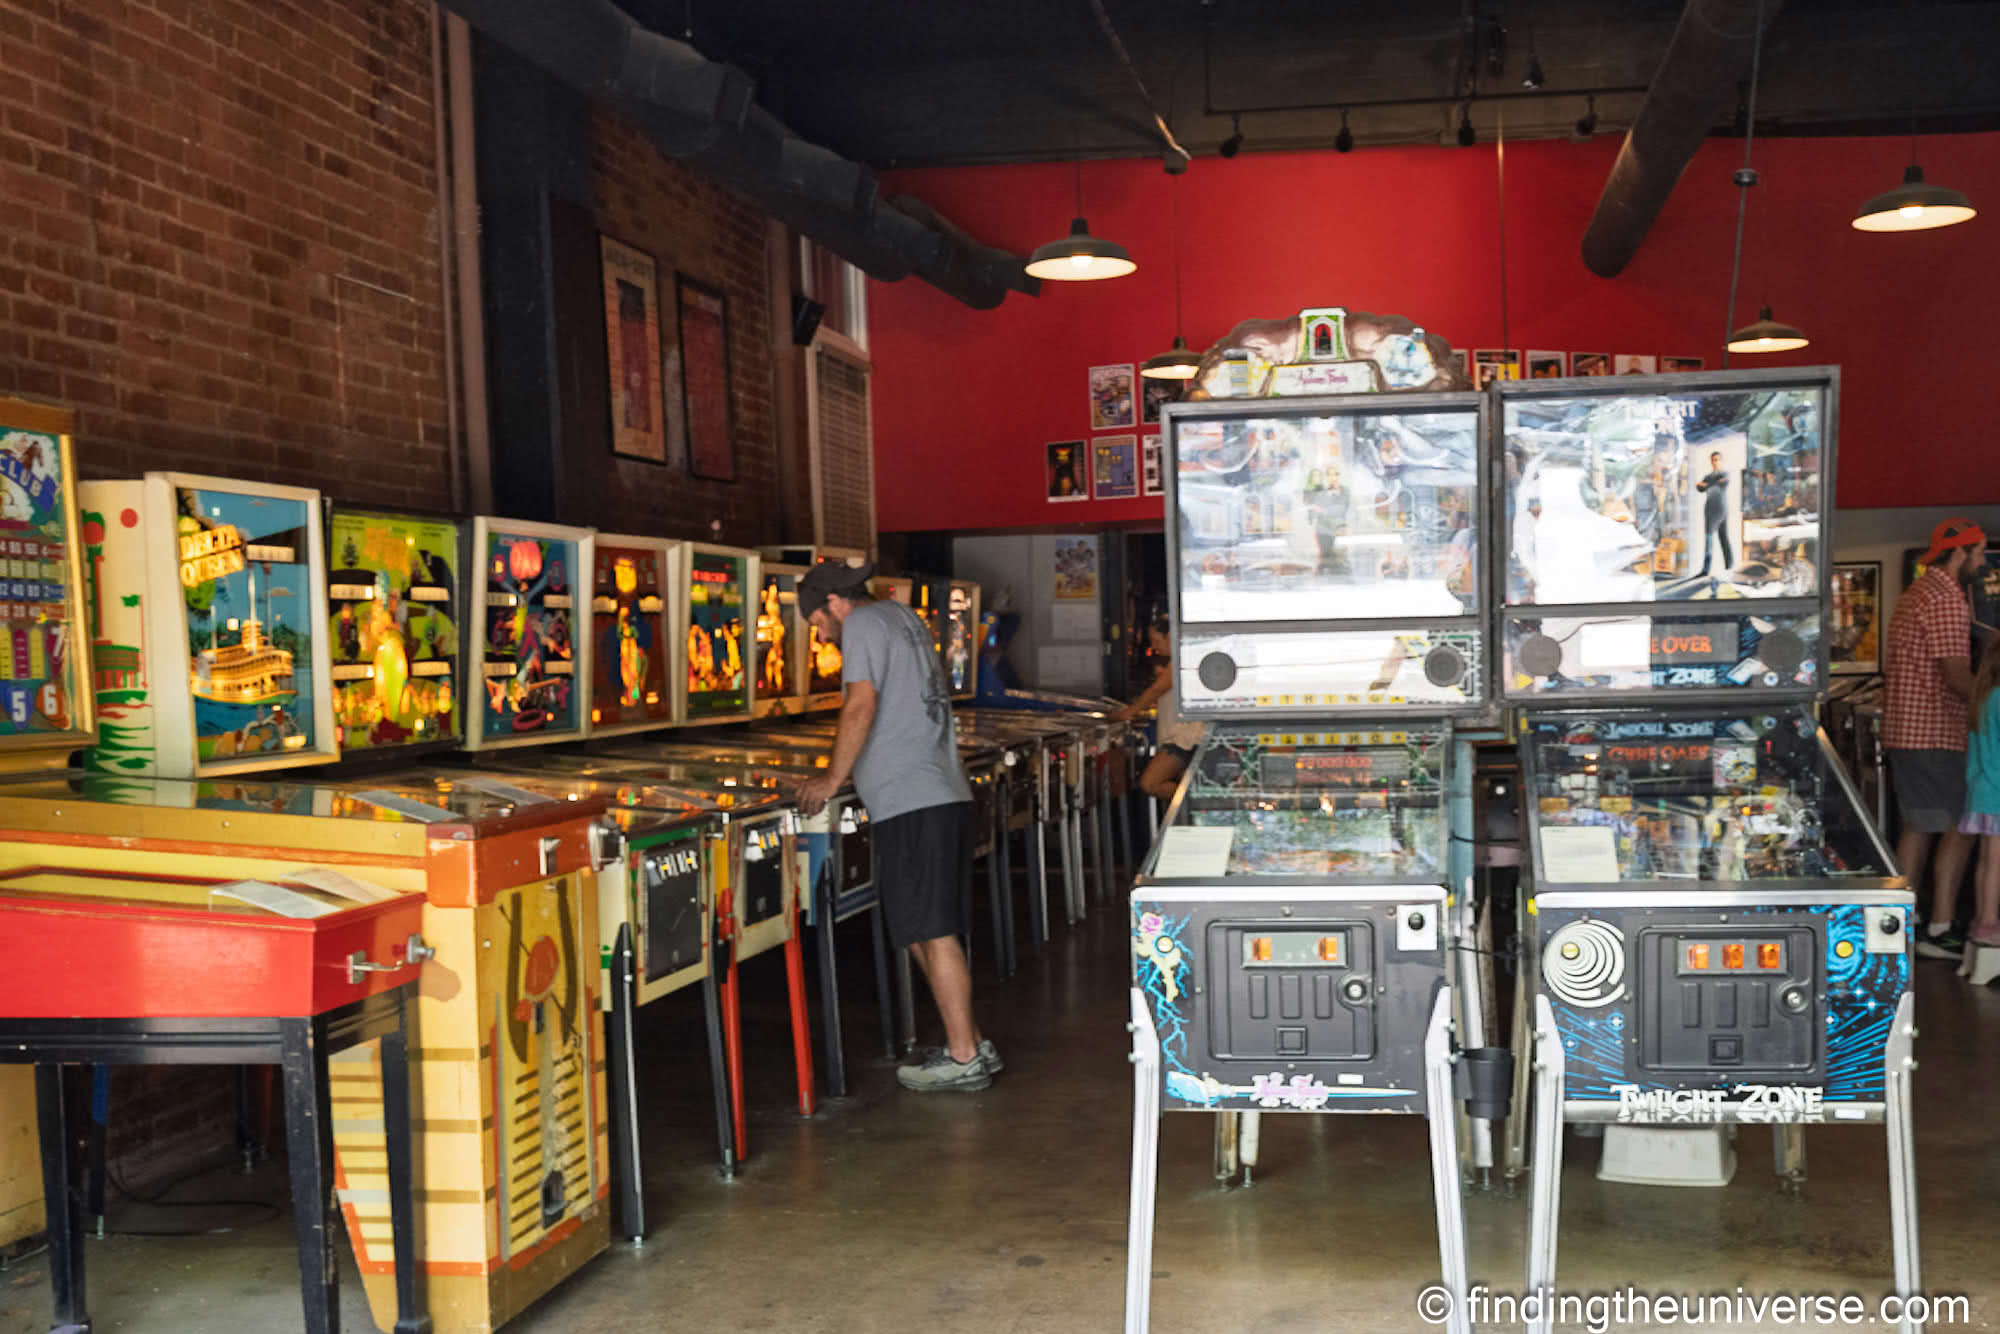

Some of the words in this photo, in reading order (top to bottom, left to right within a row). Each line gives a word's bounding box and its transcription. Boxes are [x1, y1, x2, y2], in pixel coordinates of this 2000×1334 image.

[181, 549, 244, 588] QUEEN
[51, 627, 63, 657] 7
[1661, 634, 1712, 654] OVER
[1668, 666, 1716, 684] ZONE
[12, 691, 27, 723] 5
[43, 684, 57, 716] 6
[1610, 1084, 1728, 1117] TWILIGHT
[1733, 1085, 1824, 1115] ZONE
